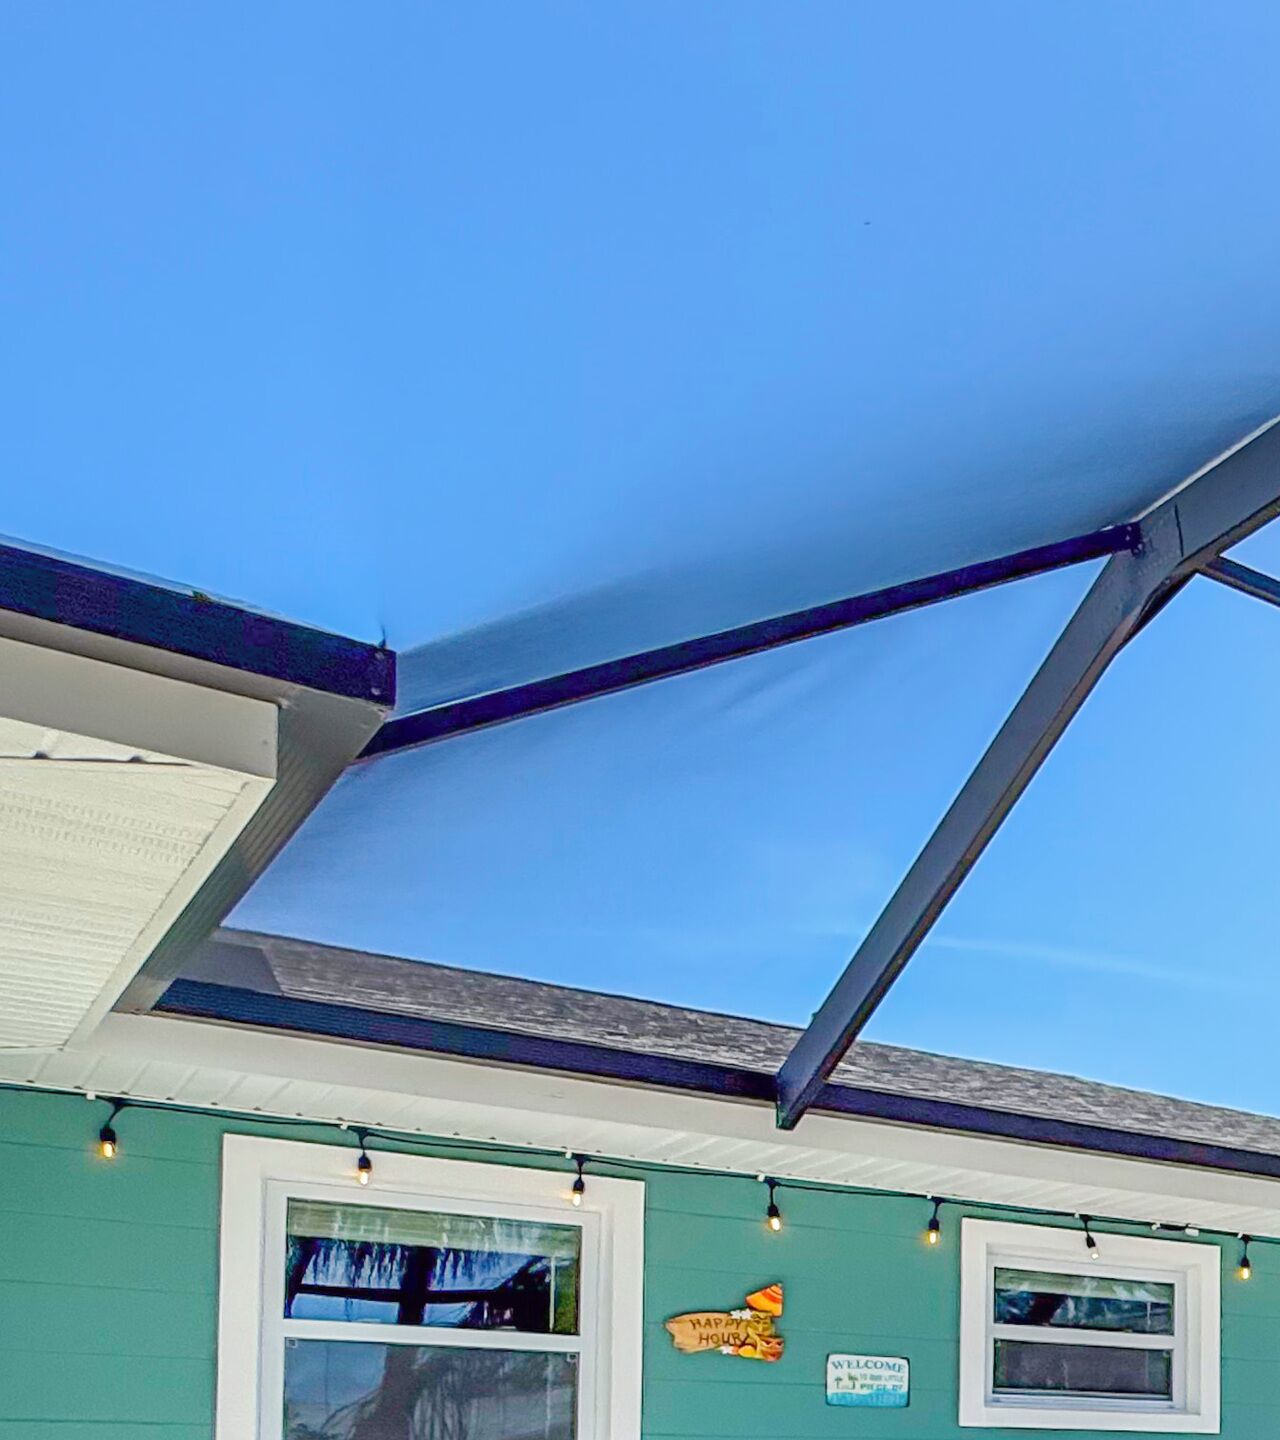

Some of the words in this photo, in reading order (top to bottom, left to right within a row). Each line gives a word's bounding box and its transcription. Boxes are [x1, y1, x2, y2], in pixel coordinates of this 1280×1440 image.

[689, 1317, 743, 1330] HAPPY
[698, 1332, 744, 1346] HOUR
[831, 1359, 906, 1373] WELCOME
